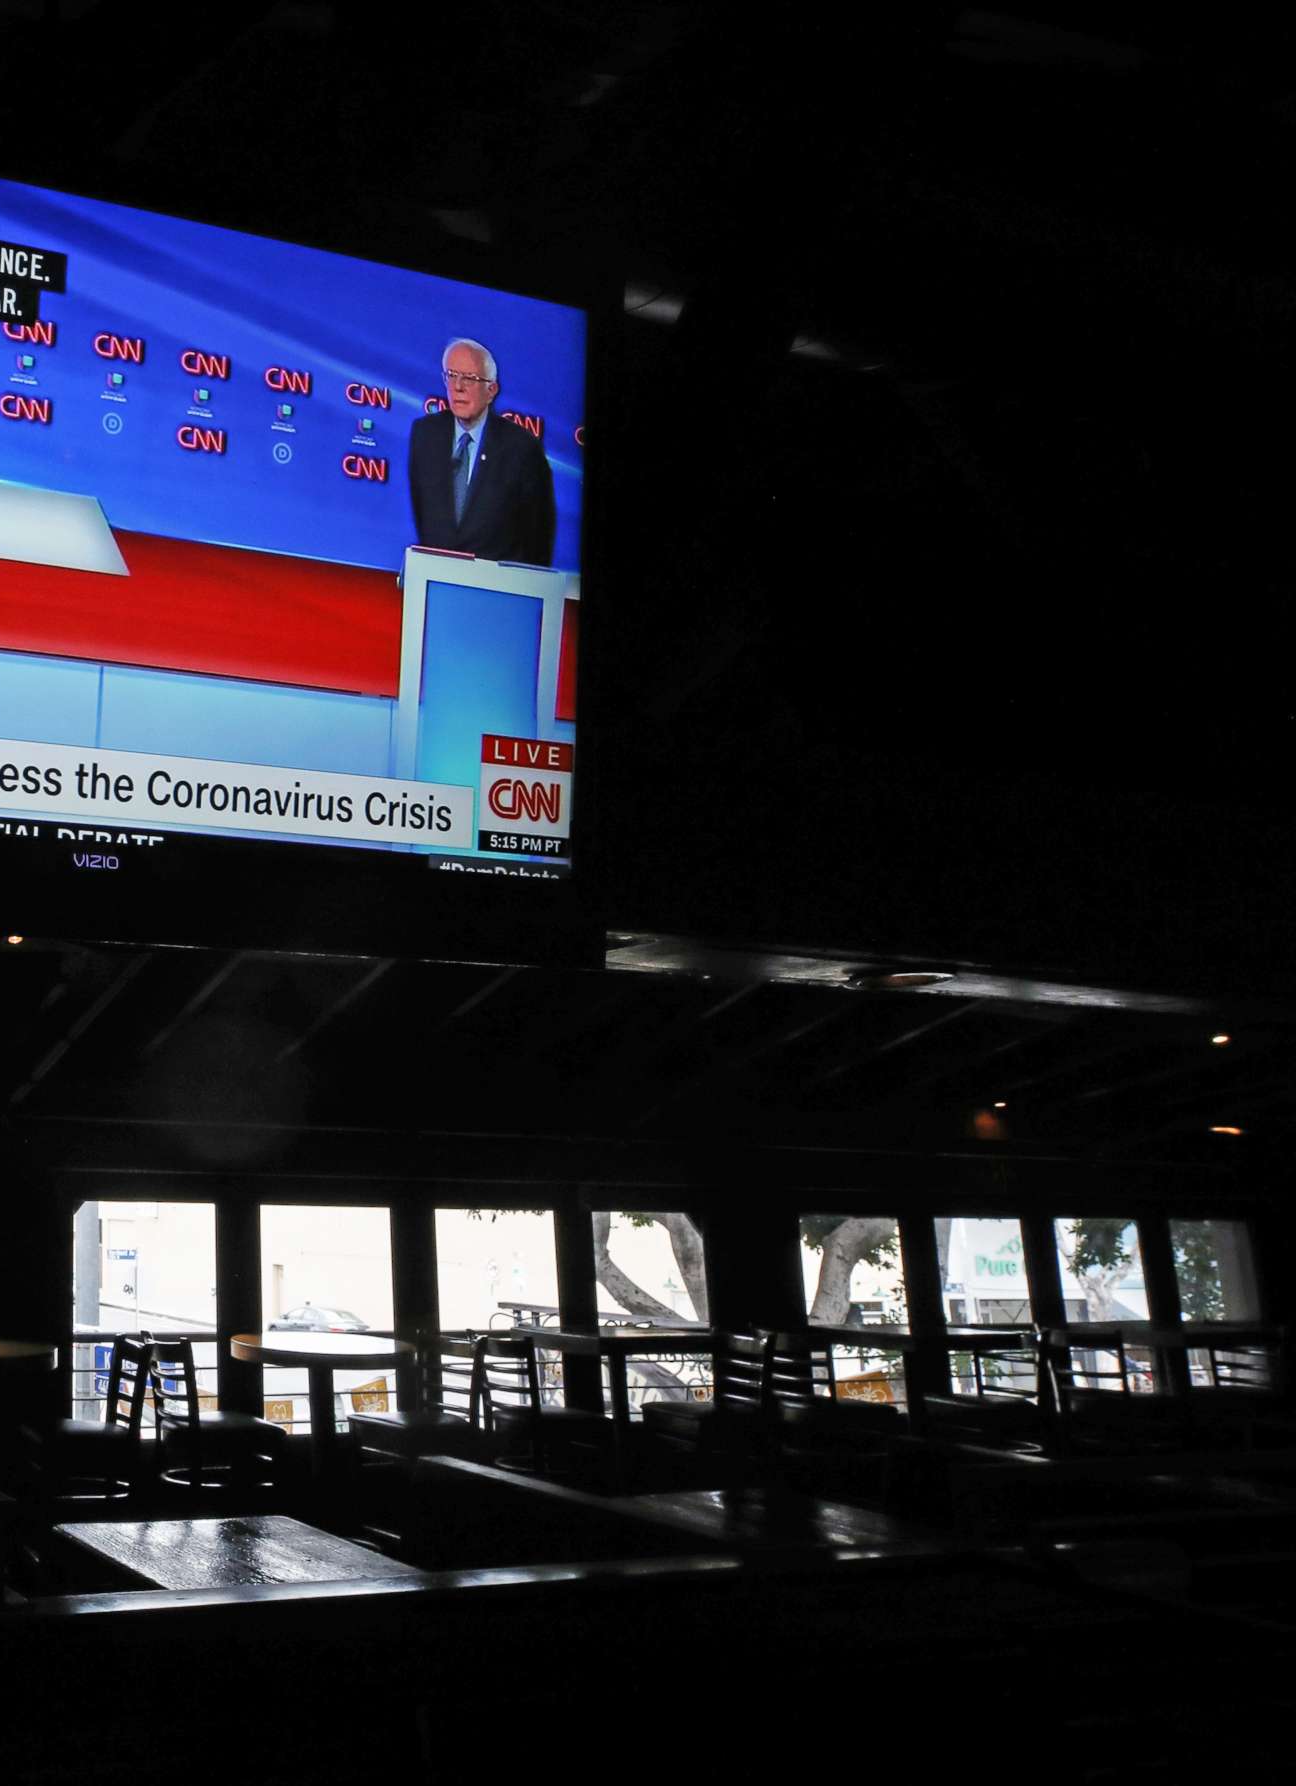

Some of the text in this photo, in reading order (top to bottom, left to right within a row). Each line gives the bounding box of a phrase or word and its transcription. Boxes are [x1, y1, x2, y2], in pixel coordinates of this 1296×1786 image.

[93, 333, 143, 363] CNN
[179, 350, 229, 380] CNN
[264, 366, 312, 396] CNN
[344, 382, 391, 410] CNN
[176, 426, 225, 453] CNN
[341, 454, 387, 482] CNN
[494, 739, 561, 766] LIVE
[75, 762, 134, 803] the
[147, 768, 353, 824] Coronavirus
[364, 788, 452, 832] Crisis
[488, 778, 561, 824] CNN
[489, 834, 561, 853] 5:15 PM PT
[72, 852, 119, 870] VIZIO
